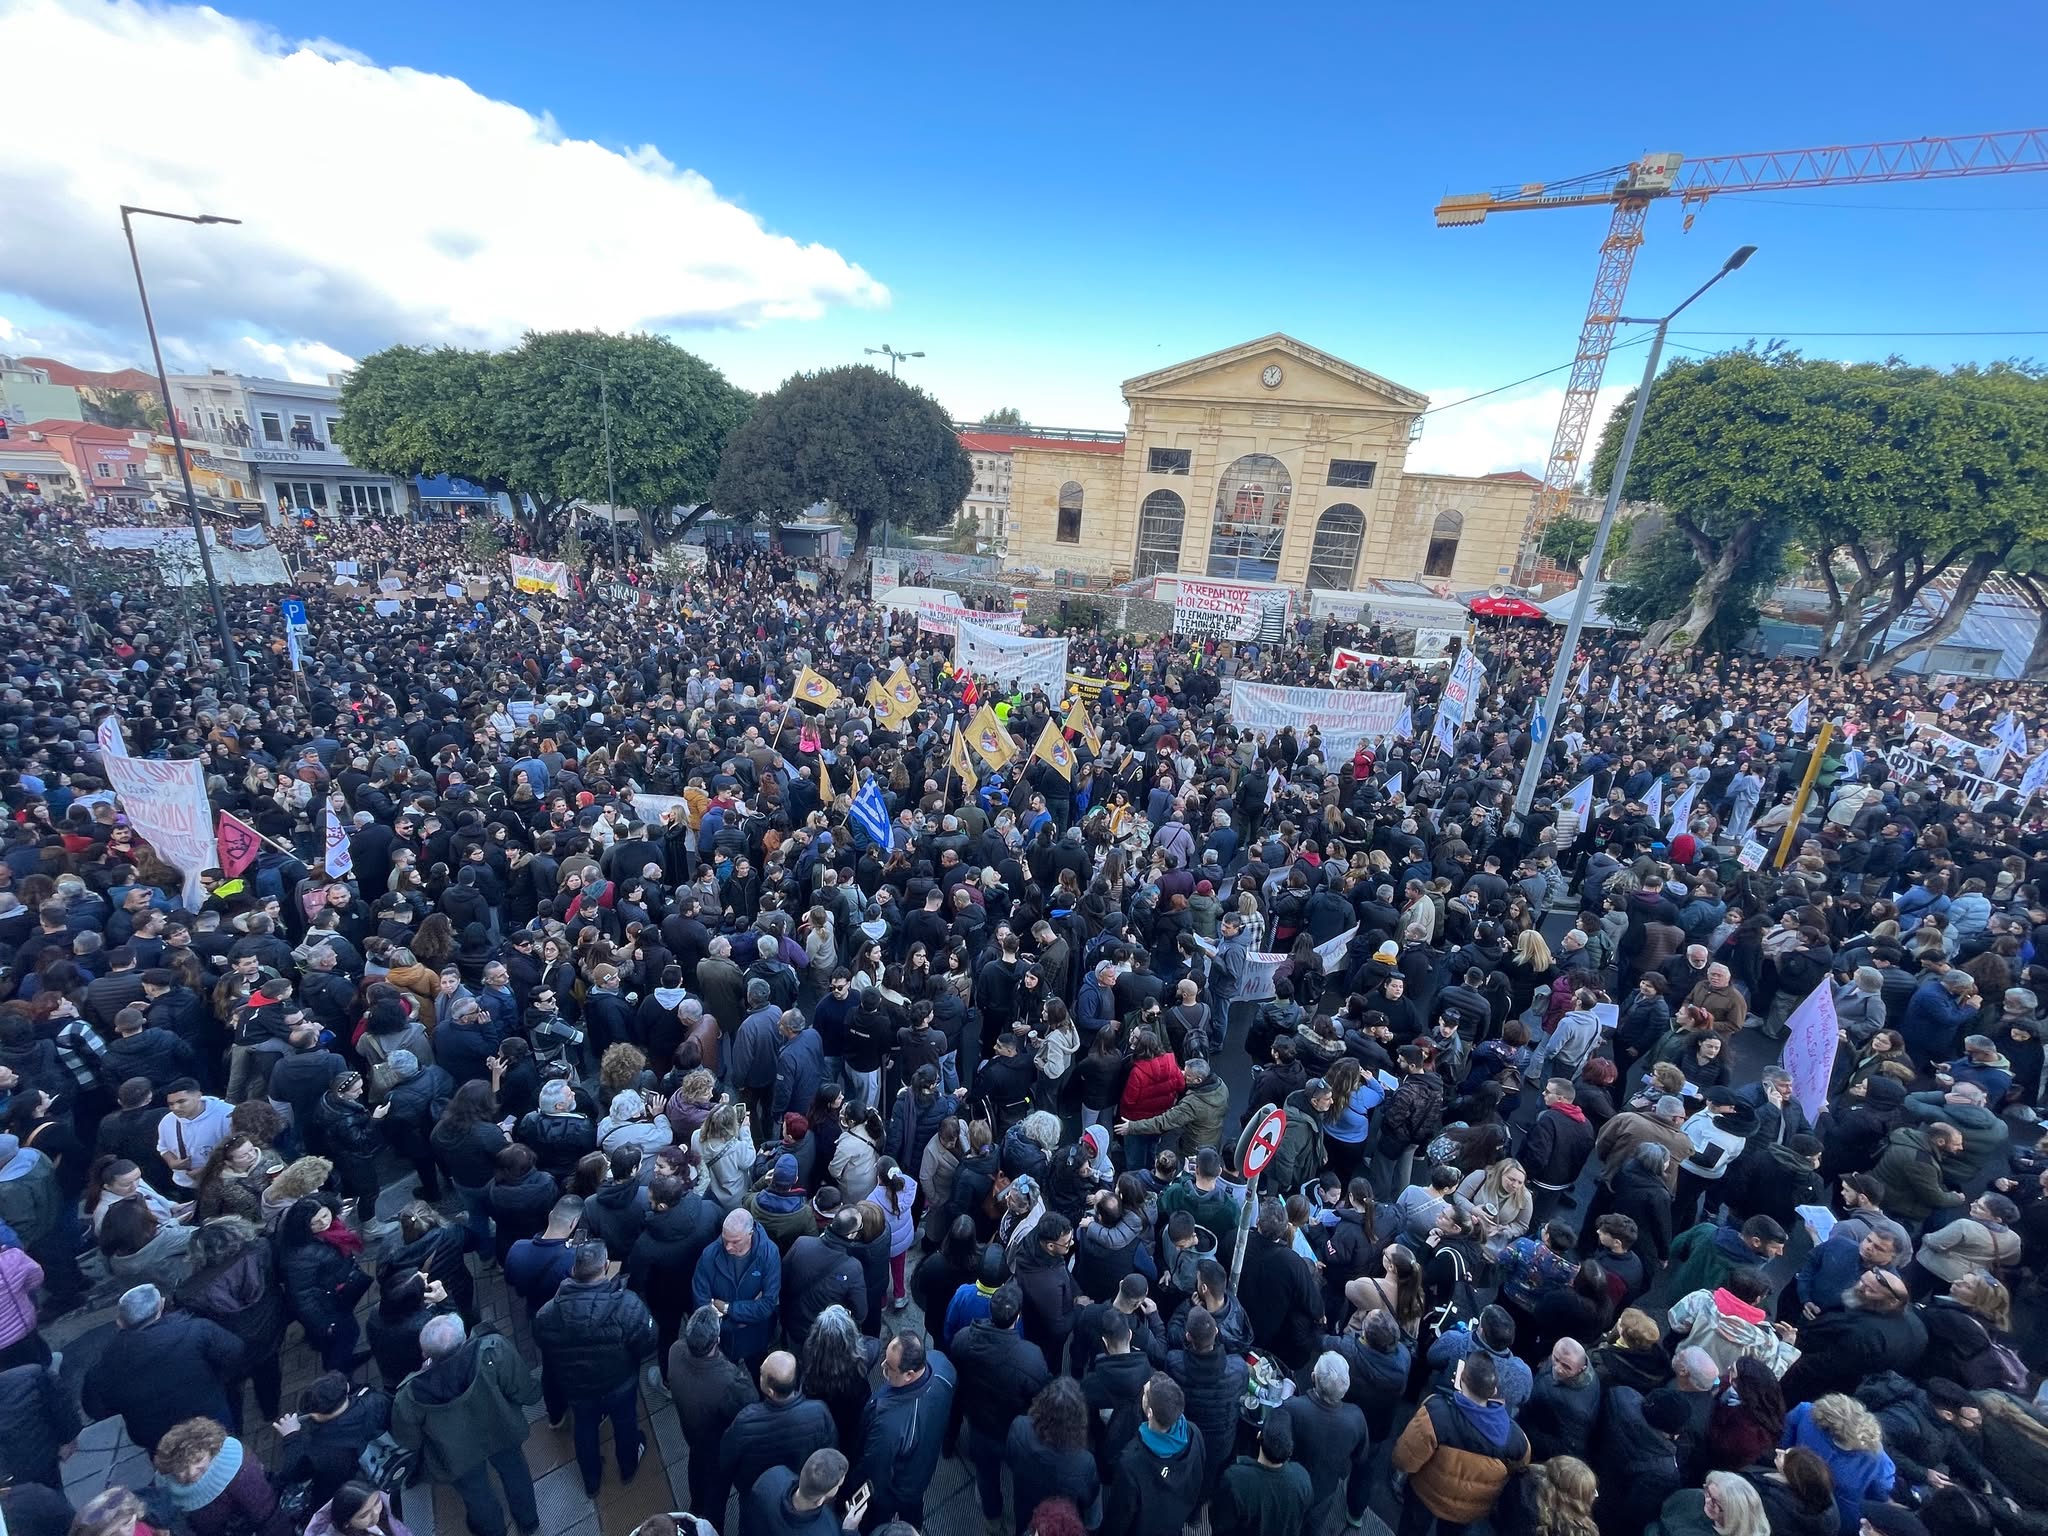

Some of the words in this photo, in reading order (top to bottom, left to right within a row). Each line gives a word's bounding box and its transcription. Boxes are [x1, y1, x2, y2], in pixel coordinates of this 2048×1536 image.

[254, 452, 300, 462] ΘΕΑΤΡΟ
[1181, 582, 1194, 594] ΤΑ
[1196, 586, 1226, 598] ΚΕΡΔΗ
[1226, 590, 1252, 602] ΤΟΥΣ
[1176, 597, 1183, 607] Η
[1186, 597, 1195, 608] ΟΙ
[1224, 602, 1247, 614] ΜΑΣ
[1176, 608, 1186, 618] ΤΟ
[1188, 610, 1224, 622] ΕΓΚΛΗΜΑ
[1226, 614, 1242, 625] ΣΤΑ
[1224, 622, 1237, 632] ΘΑ
